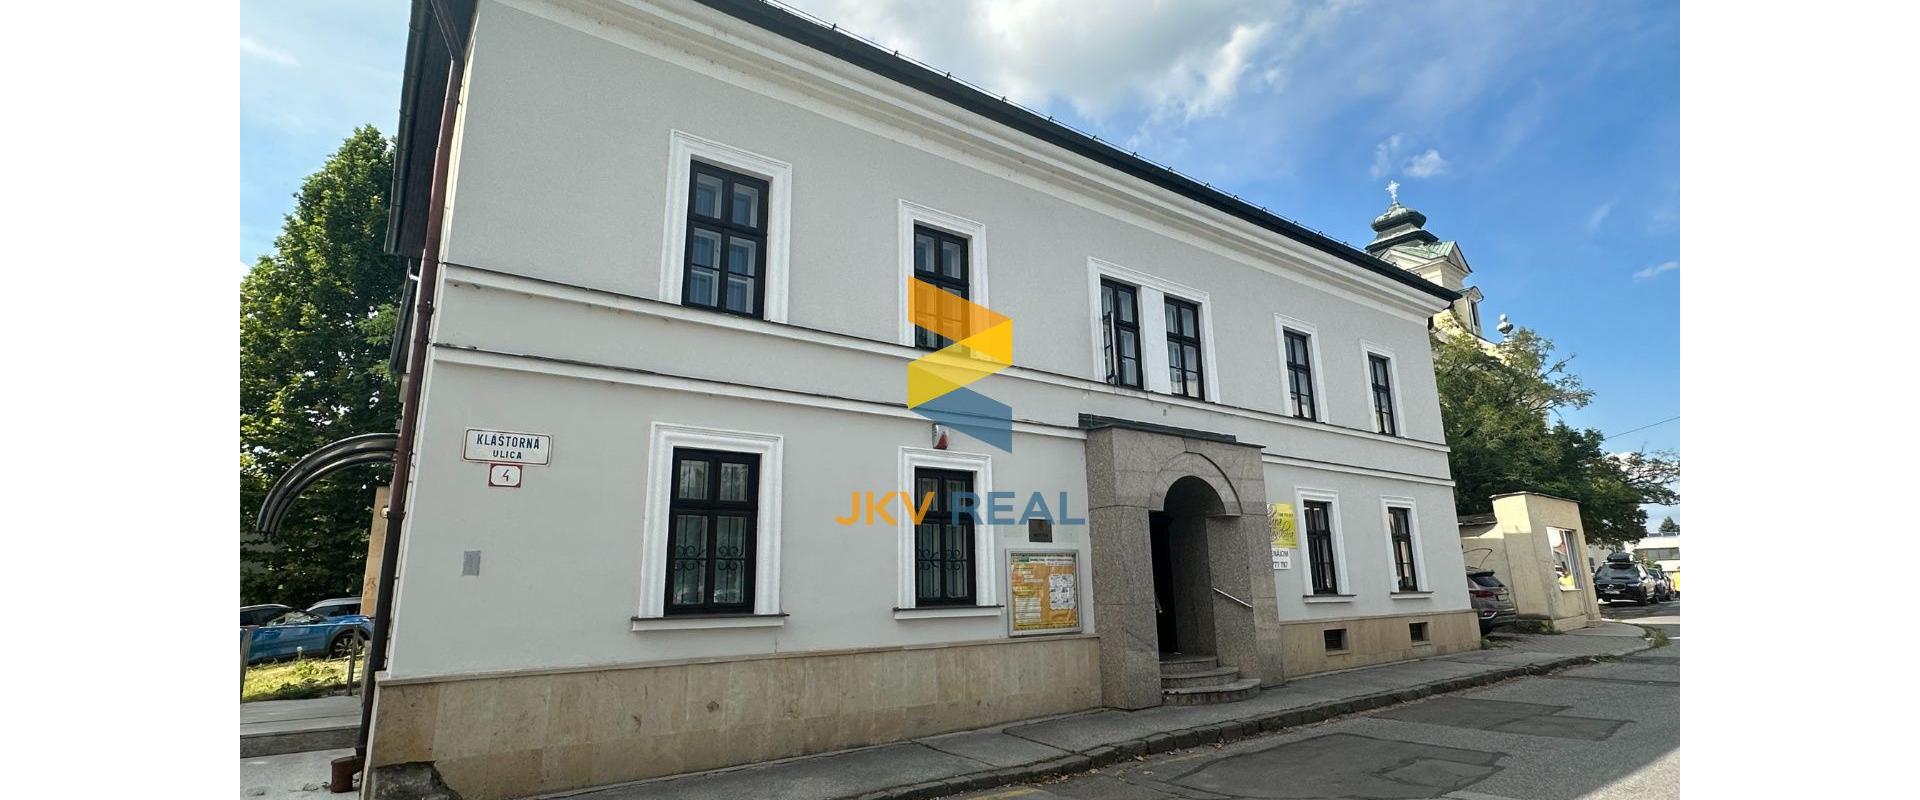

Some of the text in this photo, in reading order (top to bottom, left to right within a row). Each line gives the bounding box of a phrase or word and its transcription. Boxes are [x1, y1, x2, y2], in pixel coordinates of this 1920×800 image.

[476, 433, 540, 449] KLÁŠTORNÁ
[492, 450, 522, 459] ULICA
[502, 469, 510, 482] 4
